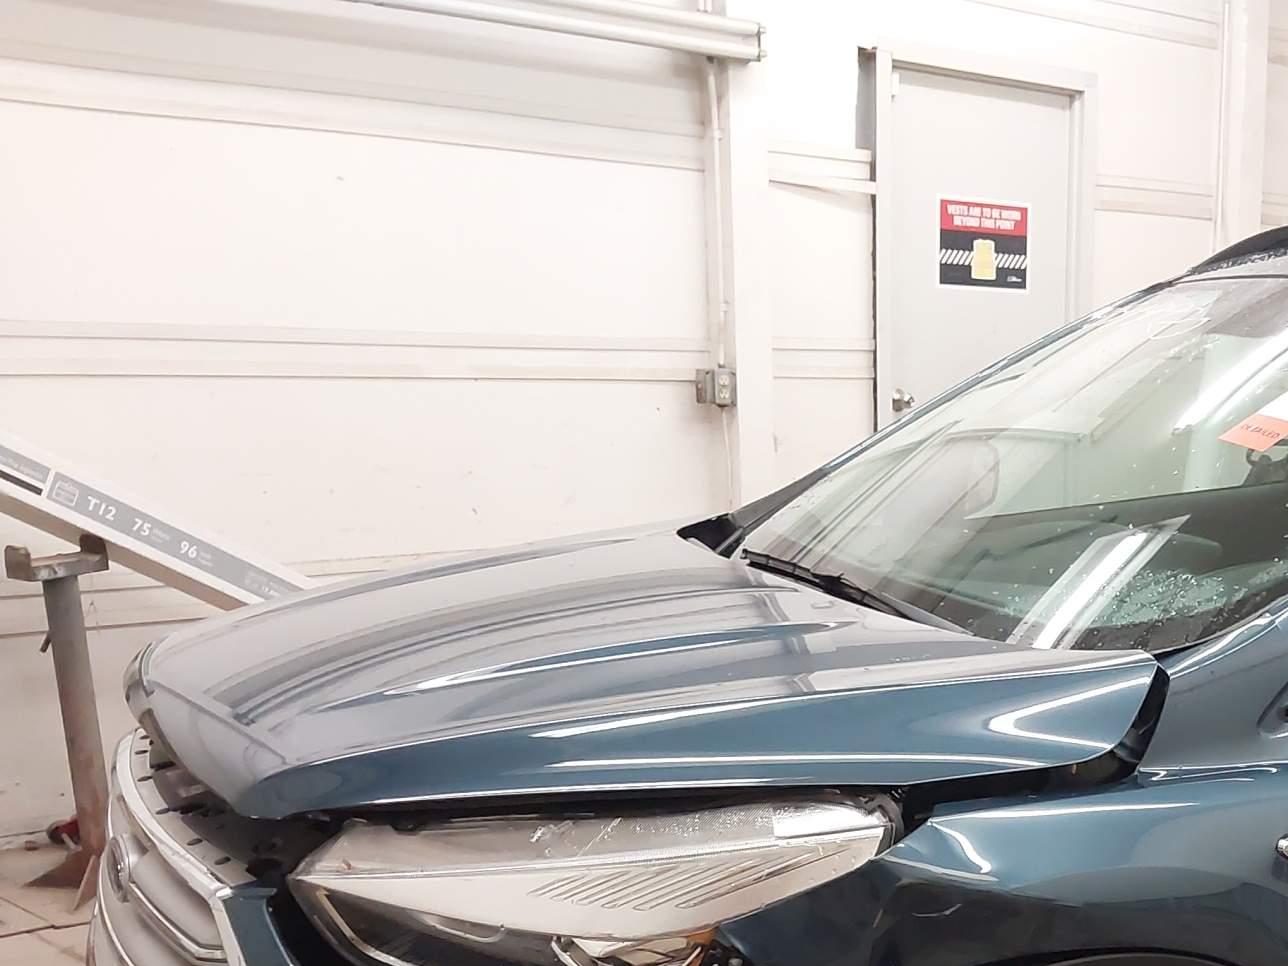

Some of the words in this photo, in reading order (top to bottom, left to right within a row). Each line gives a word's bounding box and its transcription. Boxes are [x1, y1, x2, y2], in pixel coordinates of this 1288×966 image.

[946, 204, 968, 216] VESTS
[969, 205, 982, 217] ARE
[982, 207, 992, 218] TO
[992, 208, 1001, 219] BE
[953, 215, 980, 228] BEYOND
[981, 217, 996, 229] THIS
[996, 219, 1017, 231] POINT
[87, 496, 117, 521] T12
[131, 518, 152, 537] 75
[179, 540, 198, 558] 96
